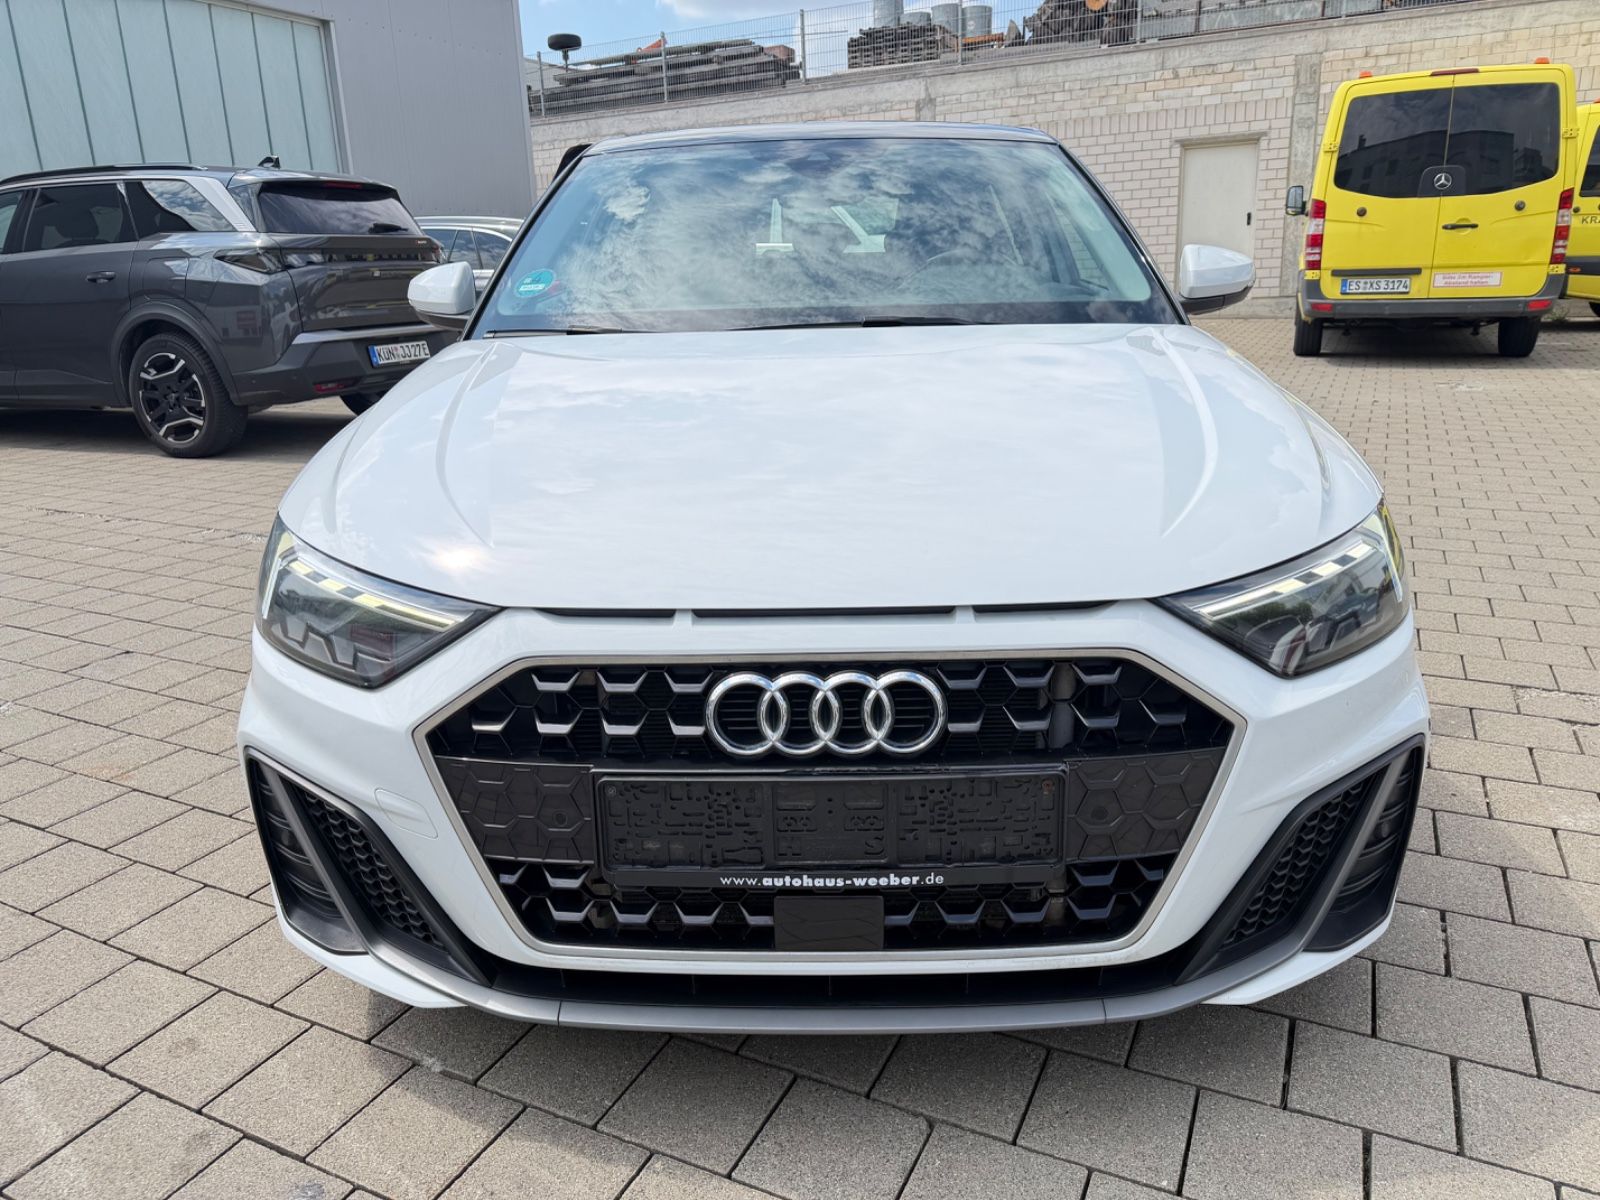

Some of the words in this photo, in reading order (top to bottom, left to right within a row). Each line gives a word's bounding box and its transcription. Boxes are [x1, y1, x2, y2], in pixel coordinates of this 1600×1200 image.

[1581, 215, 1600, 224] KR
[1348, 280, 1360, 291] ES
[1369, 280, 1381, 290] XS
[1383, 279, 1408, 290] 3174
[719, 872, 945, 887] www.autohaus-weeber.de
